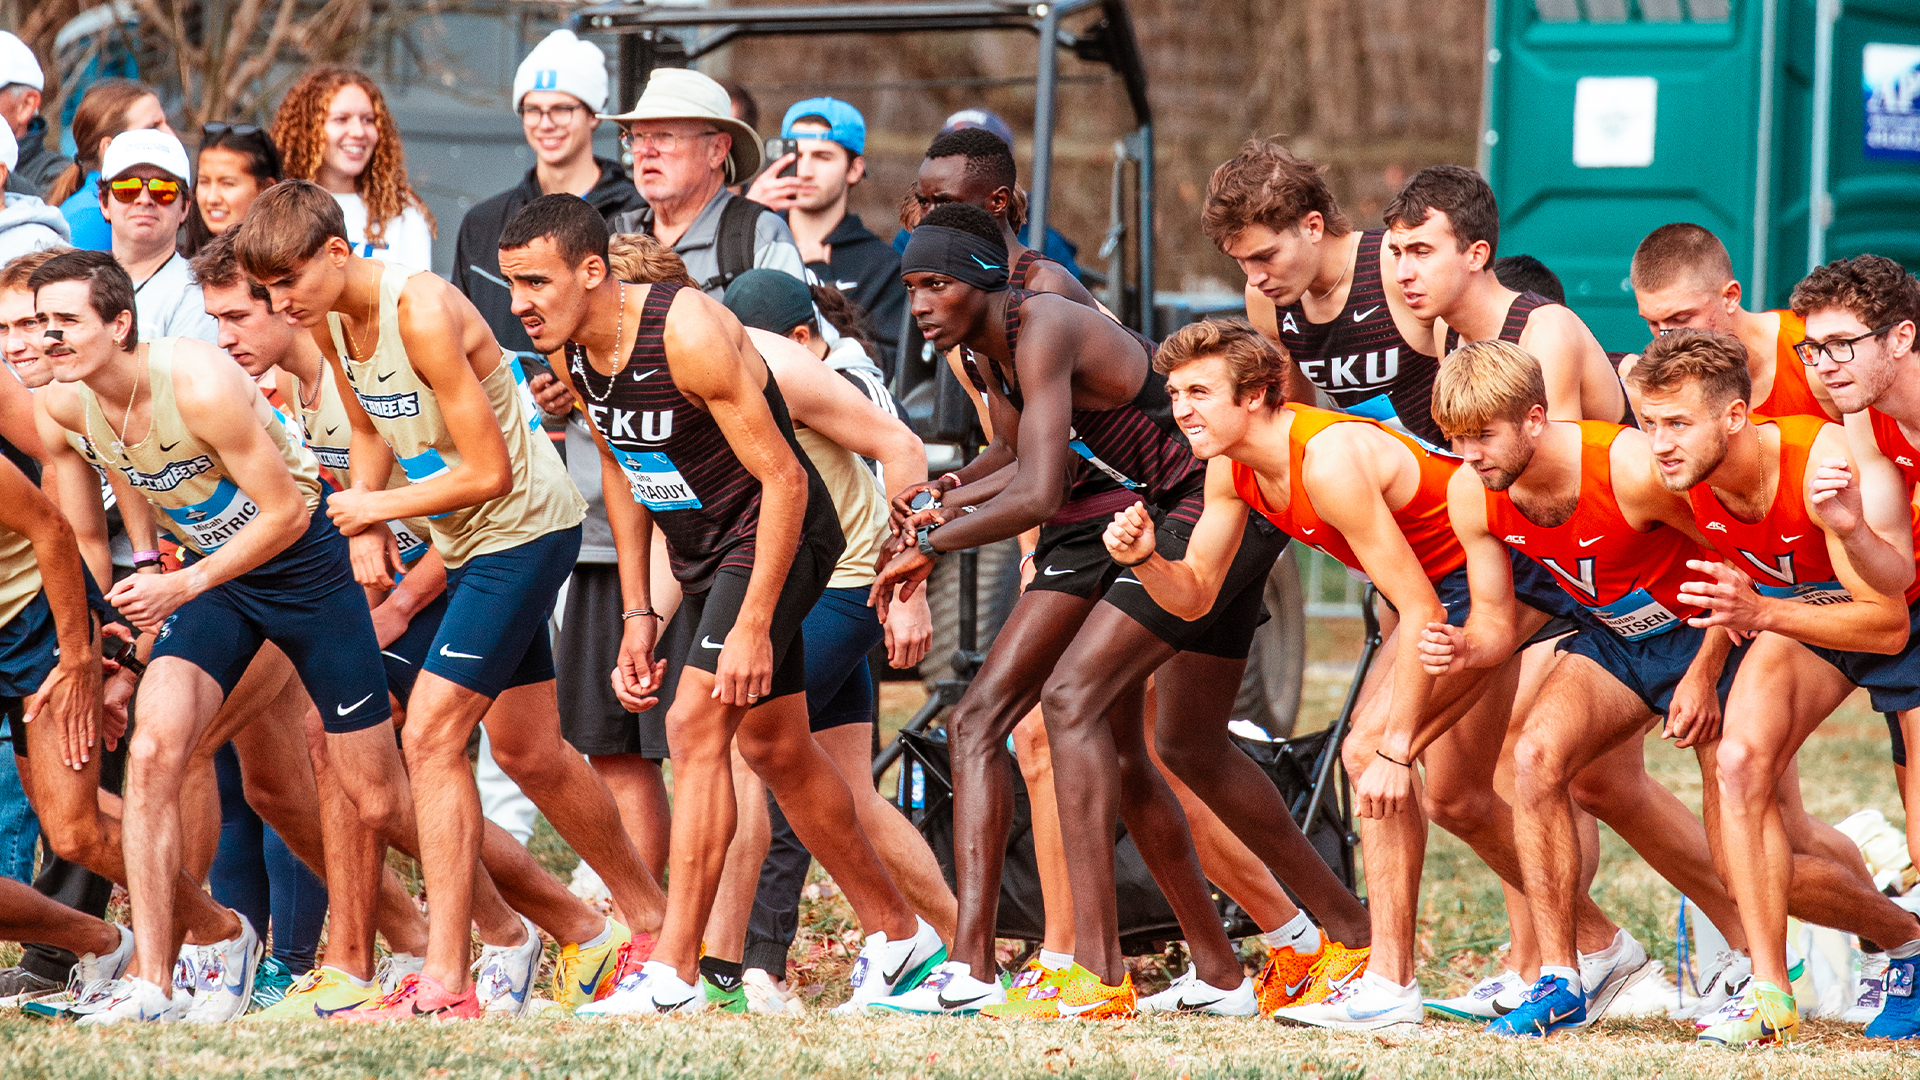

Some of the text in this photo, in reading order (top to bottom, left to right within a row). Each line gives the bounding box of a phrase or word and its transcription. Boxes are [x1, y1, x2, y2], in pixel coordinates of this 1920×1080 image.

[1299, 347, 1399, 387] EKU
[588, 403, 673, 441] EKU
[192, 517, 223, 532] Micah
[1537, 556, 1598, 599] V
[1735, 547, 1795, 585] V
[1888, 987, 1907, 995] LYNX
